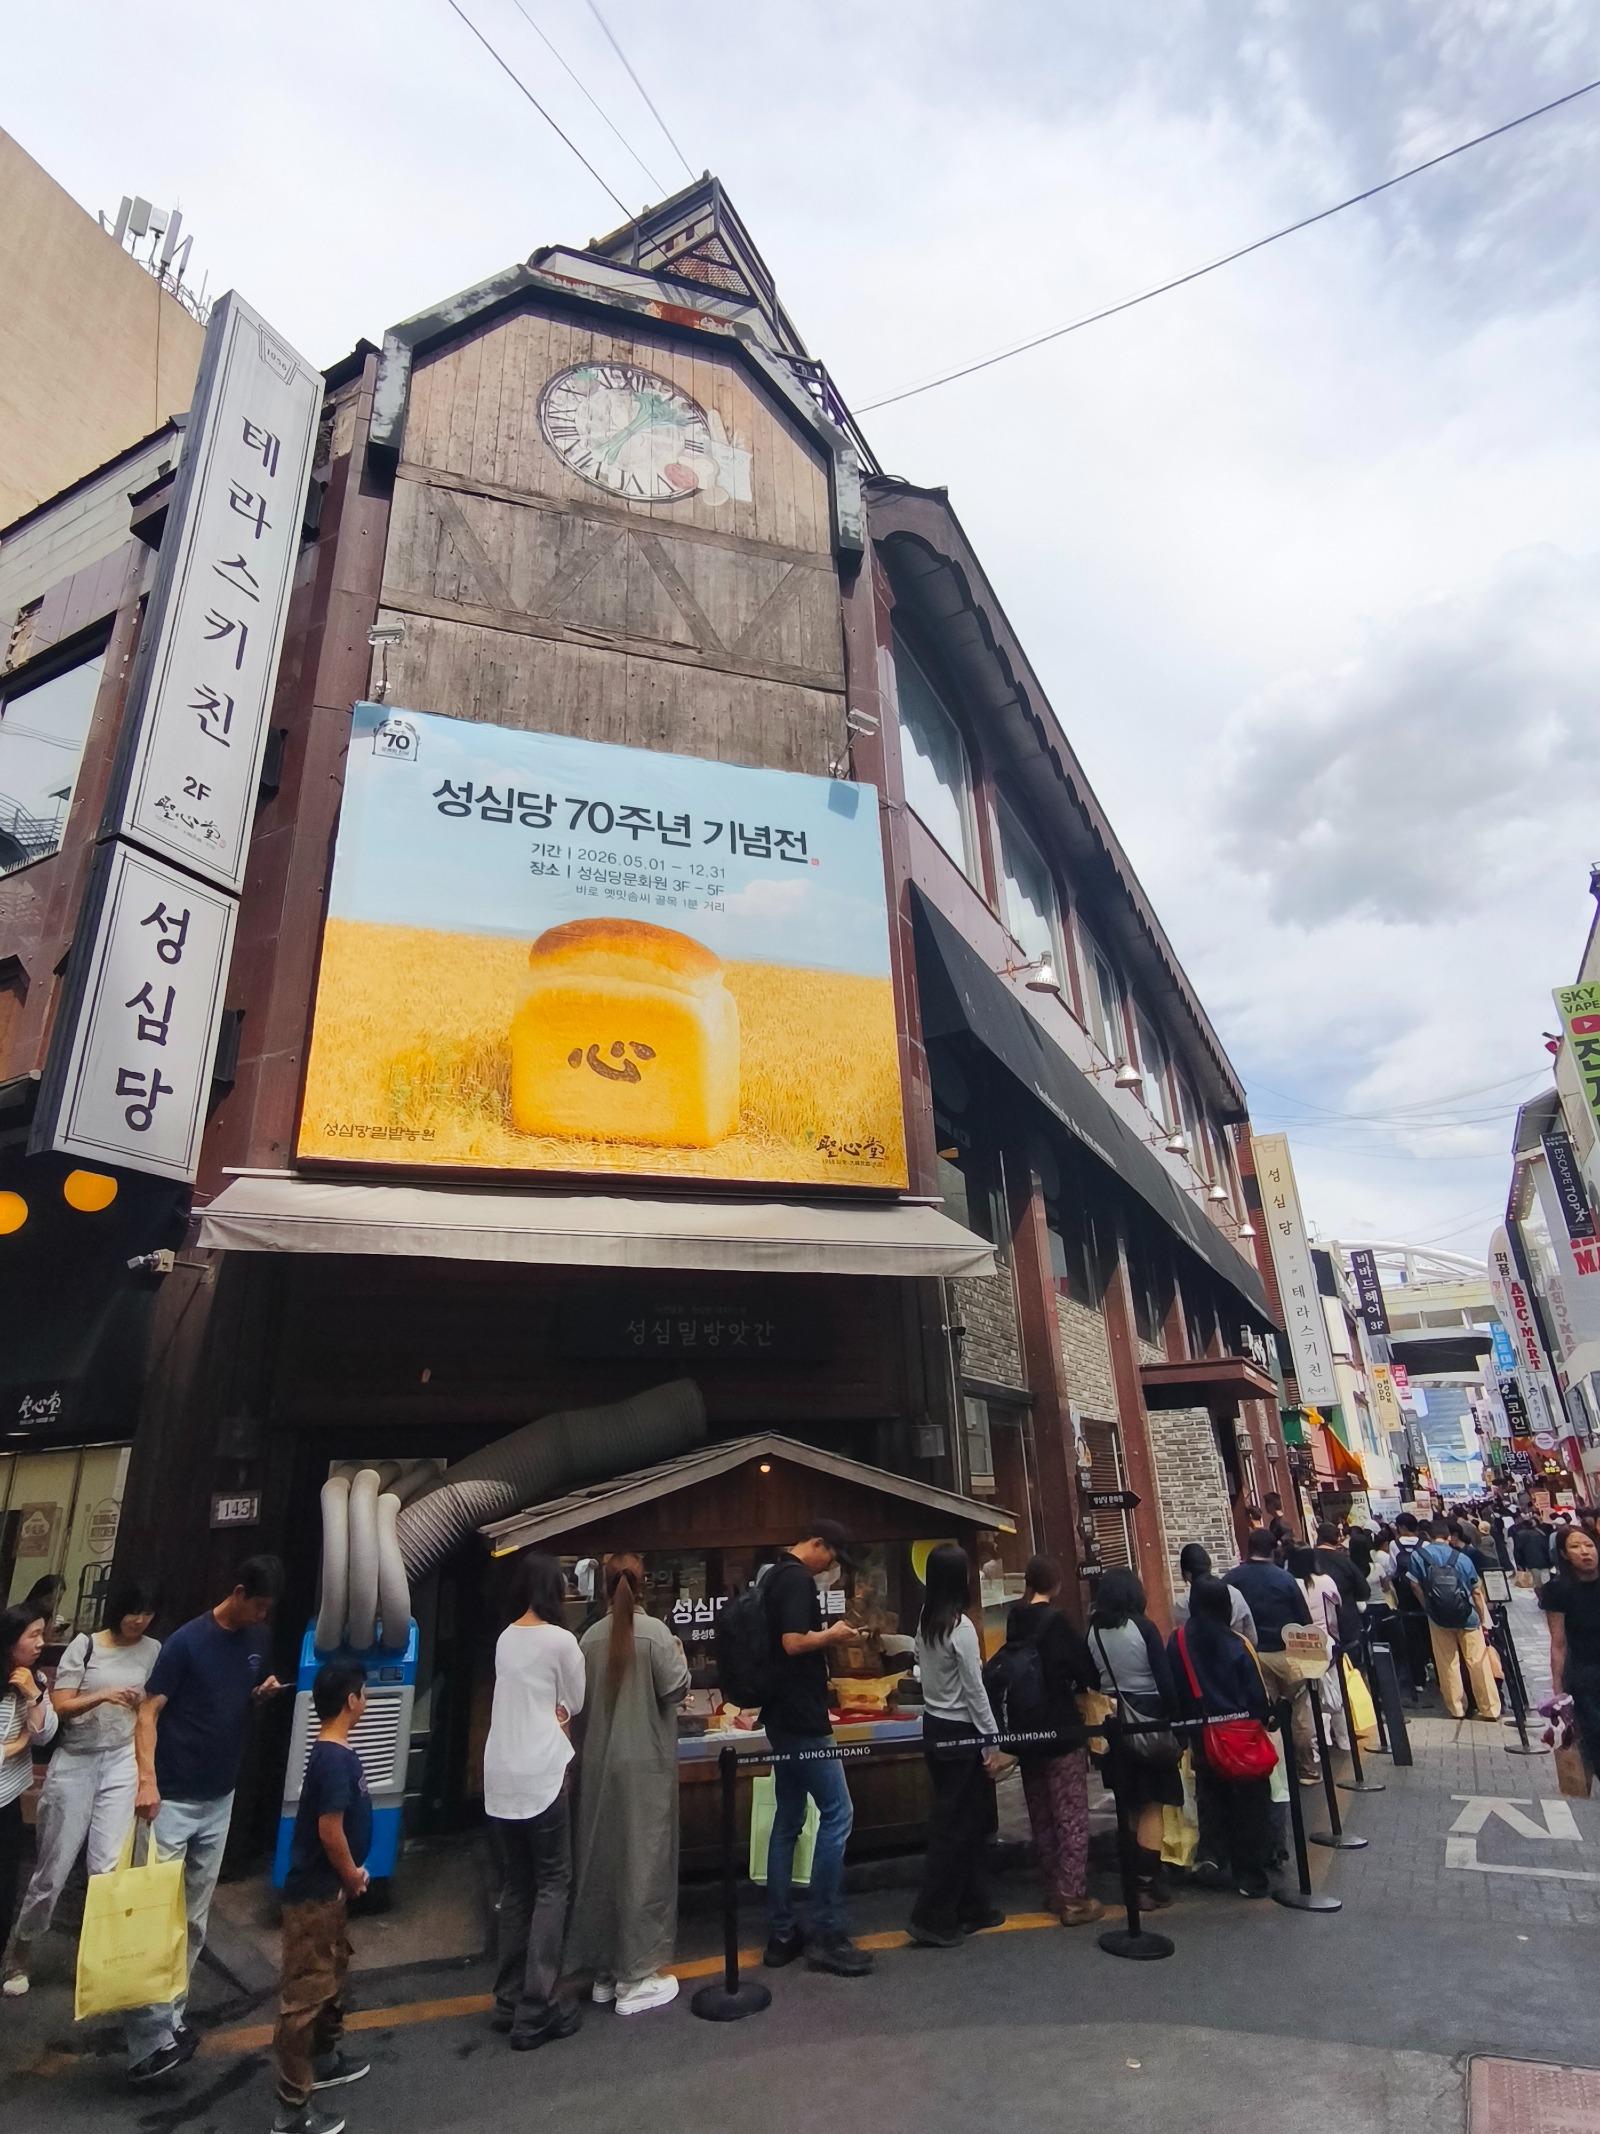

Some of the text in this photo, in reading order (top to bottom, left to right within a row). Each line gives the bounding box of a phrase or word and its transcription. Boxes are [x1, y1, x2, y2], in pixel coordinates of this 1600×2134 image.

[187, 416, 282, 749] 테라스키친
[383, 732, 410, 750] 70
[183, 775, 212, 800] 2F
[432, 779, 809, 865] 성심당 70주년 기념전
[531, 842, 562, 859] 기간
[577, 848, 666, 872] 2026.05.01
[688, 863, 726, 880] 12.31
[529, 861, 561, 877] 장소
[672, 879, 691, 892] 3F
[707, 883, 725, 896] 5F
[703, 900, 725, 913] 거리
[1560, 986, 1596, 1004] SKY
[1563, 1000, 1600, 1014] VAPE
[116, 901, 191, 1133] 성심당
[1553, 1147, 1573, 1185] ESCAPE
[1564, 1185, 1582, 1211] TOP
[1267, 1167, 1293, 1236] 성심당
[1356, 1252, 1385, 1331] 비바드헤어 3F
[625, 1318, 776, 1347] 성심밀방앗간
[1291, 1284, 1323, 1378] 테라스키친
[224, 1501, 250, 1517] 145
[799, 1746, 872, 1760] SUNGSIMDANG
[992, 1731, 1057, 1743] SUNGSIMDANG
